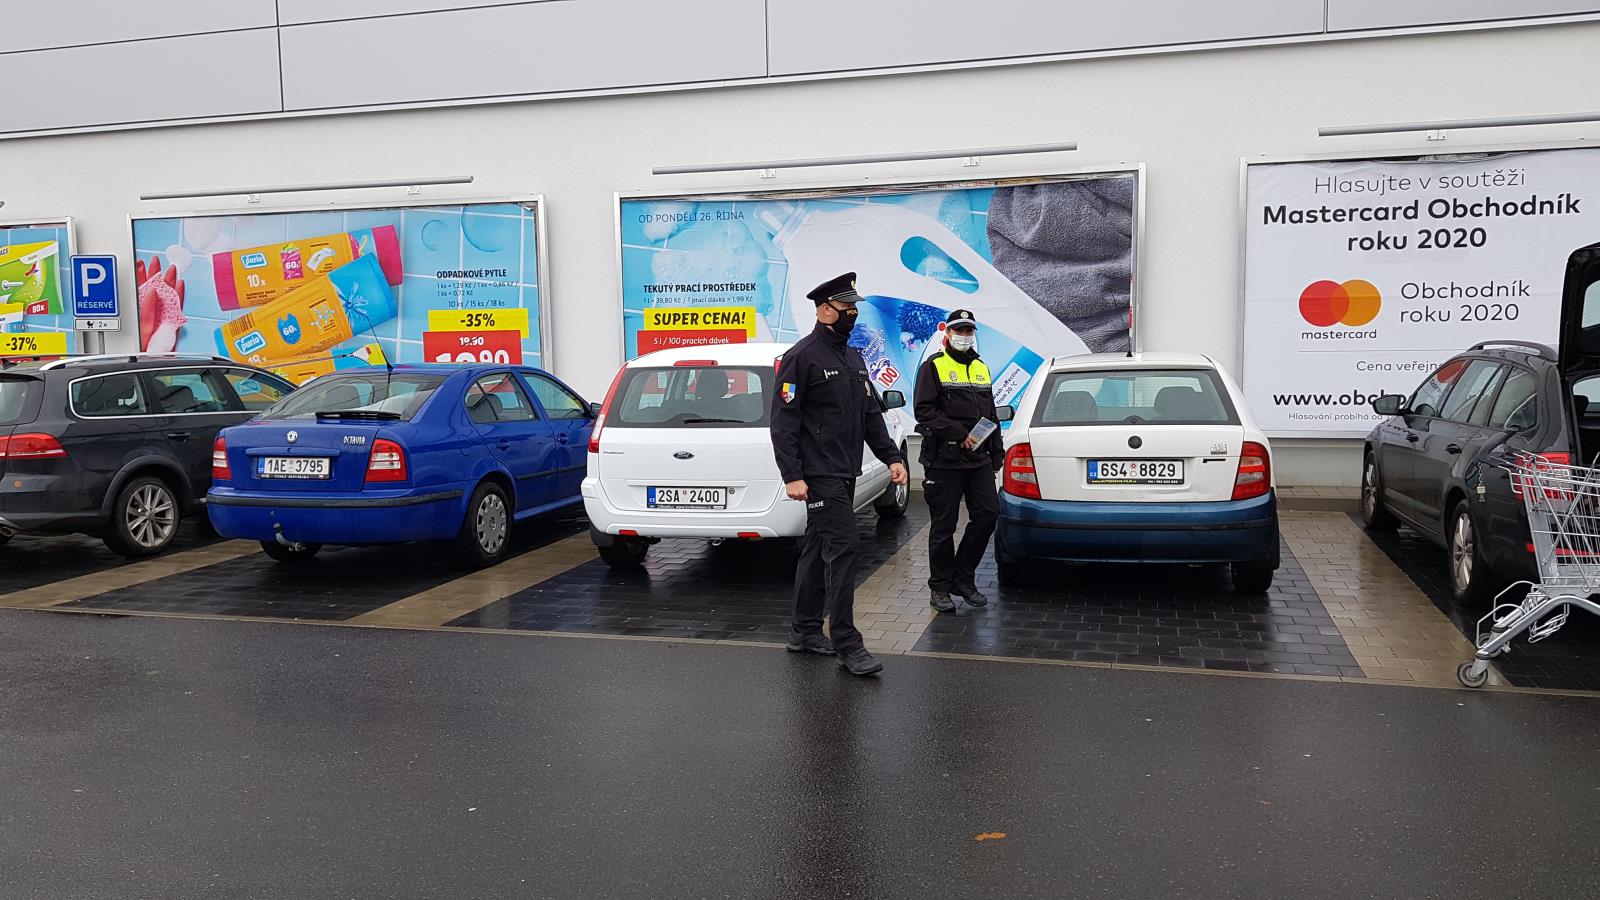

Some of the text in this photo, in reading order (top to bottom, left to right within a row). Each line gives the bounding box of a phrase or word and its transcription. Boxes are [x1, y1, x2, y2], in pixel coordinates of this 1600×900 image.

[1314, 168, 1526, 196] Hlasujte v soutěži
[1263, 193, 1581, 225] Mastercard Obchodník
[638, 210, 745, 224] OD PONDĚLÍ 26. ŘÍJNA
[1347, 227, 1487, 251] roku 2020
[81, 263, 106, 297] P
[436, 268, 507, 279] ODPADKOVÉ PYTLE
[643, 281, 757, 293] TEKUTÝ PRACÍ PROSTŘEDEK
[1400, 280, 1531, 300] Obchodník
[77, 299, 114, 309] RÉSERVÉ
[460, 313, 495, 327] -35%
[653, 311, 746, 326] SUPER CENA!
[1400, 303, 1520, 323] roku 2020
[653, 337, 658, 345] 5
[668, 336, 681, 345] 100
[682, 335, 708, 346] pracích
[709, 335, 730, 344] dávek
[1301, 329, 1378, 341] mastercard
[6, 336, 37, 351] -37%
[1356, 360, 1443, 374] Cena veřejn
[878, 367, 898, 387] 100
[1288, 412, 1333, 421] Hlasování
[1334, 412, 1369, 422] probíhá
[343, 435, 366, 445] OCTAVIA
[267, 459, 323, 473] 1AE 3795
[1100, 463, 1128, 477] 6S4
[1139, 463, 1176, 477] 8829
[658, 489, 680, 503] 2SA
[689, 489, 720, 503] 2400
